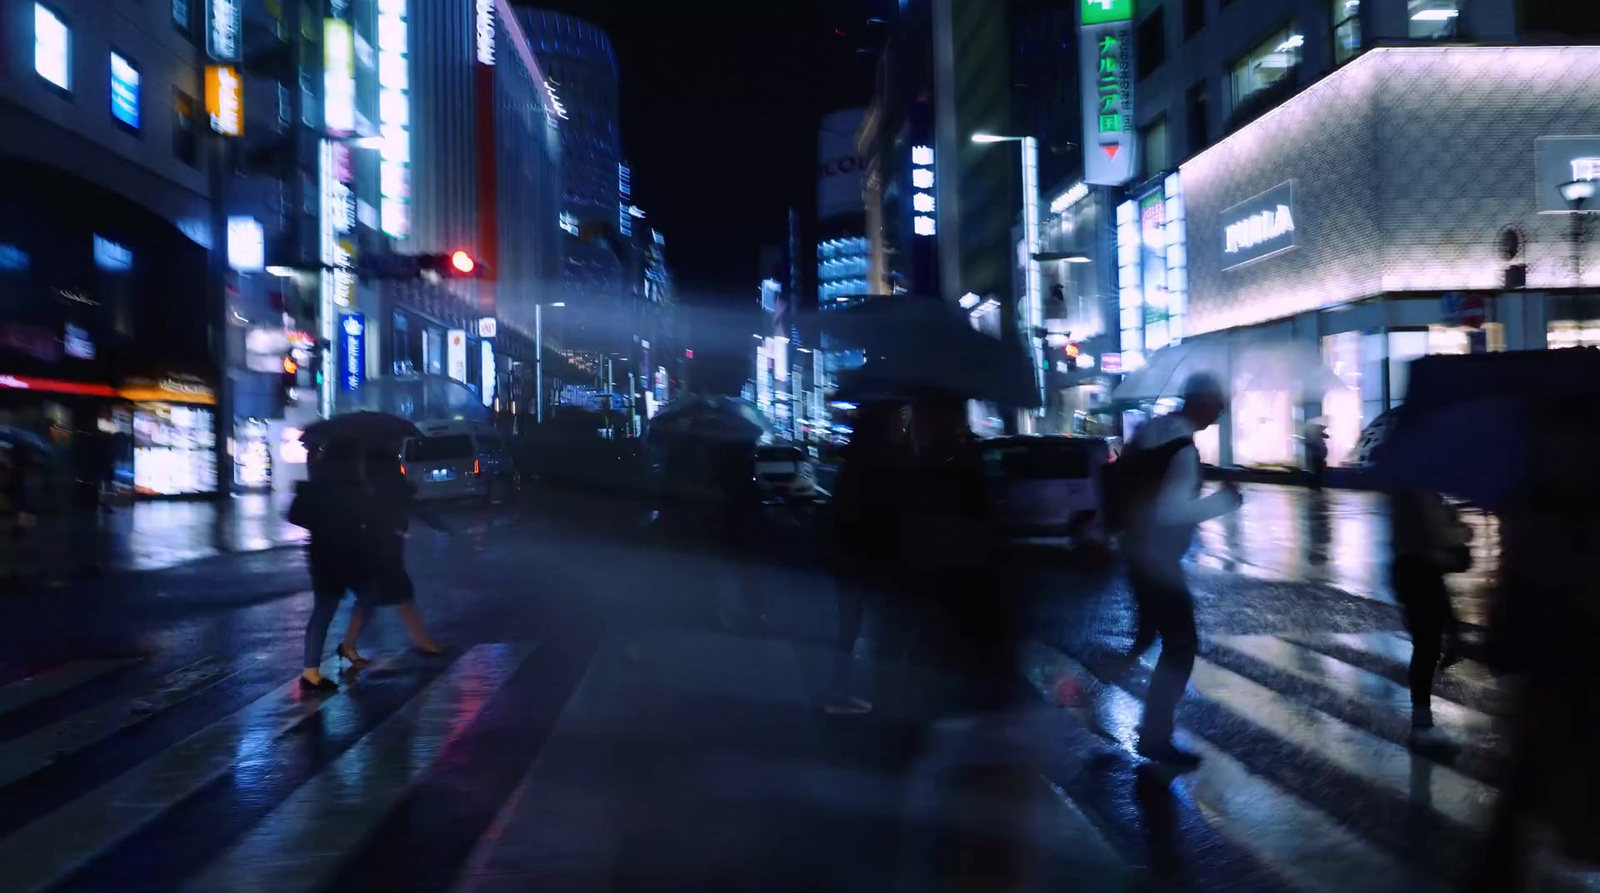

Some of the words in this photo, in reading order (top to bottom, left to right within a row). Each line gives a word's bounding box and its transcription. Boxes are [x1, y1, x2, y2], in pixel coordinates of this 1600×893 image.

[1098, 35, 1118, 132] ナルニア国
